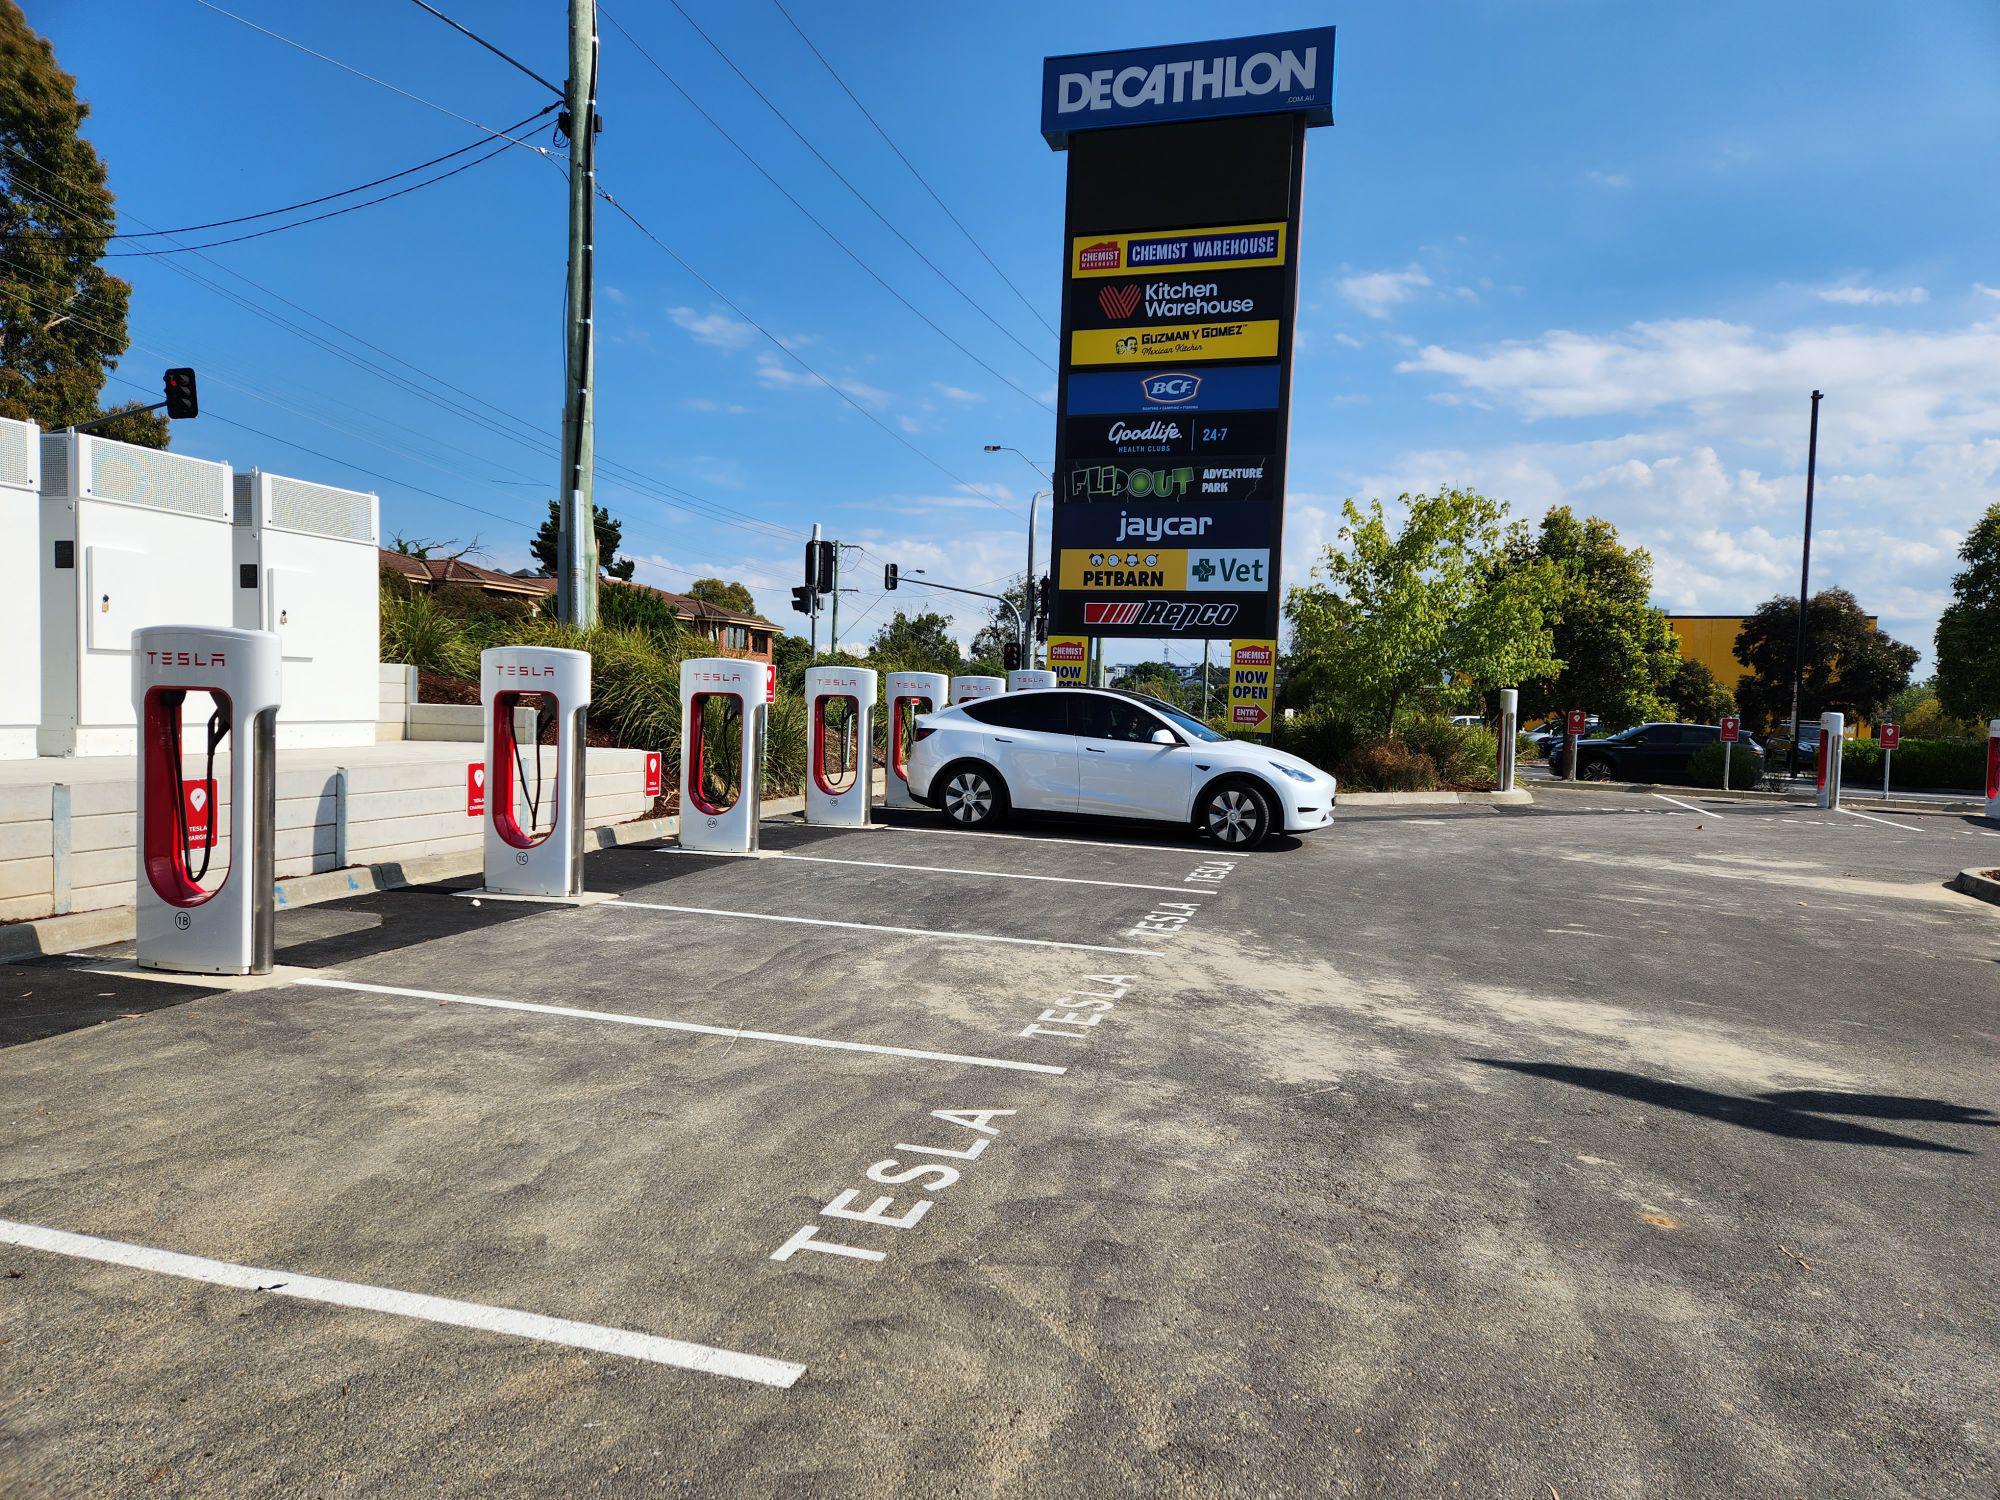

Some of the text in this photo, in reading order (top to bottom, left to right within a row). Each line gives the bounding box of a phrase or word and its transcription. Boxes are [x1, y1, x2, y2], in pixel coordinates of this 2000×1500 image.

[1057, 46, 1317, 114] DECATHLON
[1131, 236, 1275, 262] CHEMIST WAREHOUSE
[1081, 250, 1119, 262] CHEMIST
[1145, 281, 1217, 300] Kitchen
[1144, 298, 1254, 318] Warehouse
[1192, 330, 1199, 340] Y
[1142, 343, 1203, 356] Mexican Kitchen
[1151, 380, 1193, 394] BCF
[1202, 467, 1263, 479] ADVENTURE
[1202, 482, 1228, 493] PARK
[1116, 510, 1213, 542] jaycar
[1083, 558, 1264, 587] PETBARN Vet
[1052, 646, 1083, 655] CHEMIST
[1236, 650, 1270, 660] CHEMIST
[146, 651, 226, 667] TESLA
[496, 665, 555, 677] TESLA
[693, 672, 741, 682] TESLA
[1051, 666, 1082, 679] NOW
[1235, 670, 1268, 684] NOW
[817, 678, 857, 686] TESLA
[1232, 685, 1268, 699] OPEN
[1236, 708, 1259, 717] ENTRY
[188, 825, 208, 833] TESLA
[1184, 860, 1238, 883] TESLA
[177, 916, 189, 926] 1B
[1127, 902, 1201, 938] TESLA
[1018, 974, 1138, 1038] TESLA
[769, 1107, 1018, 1262] TESLA
